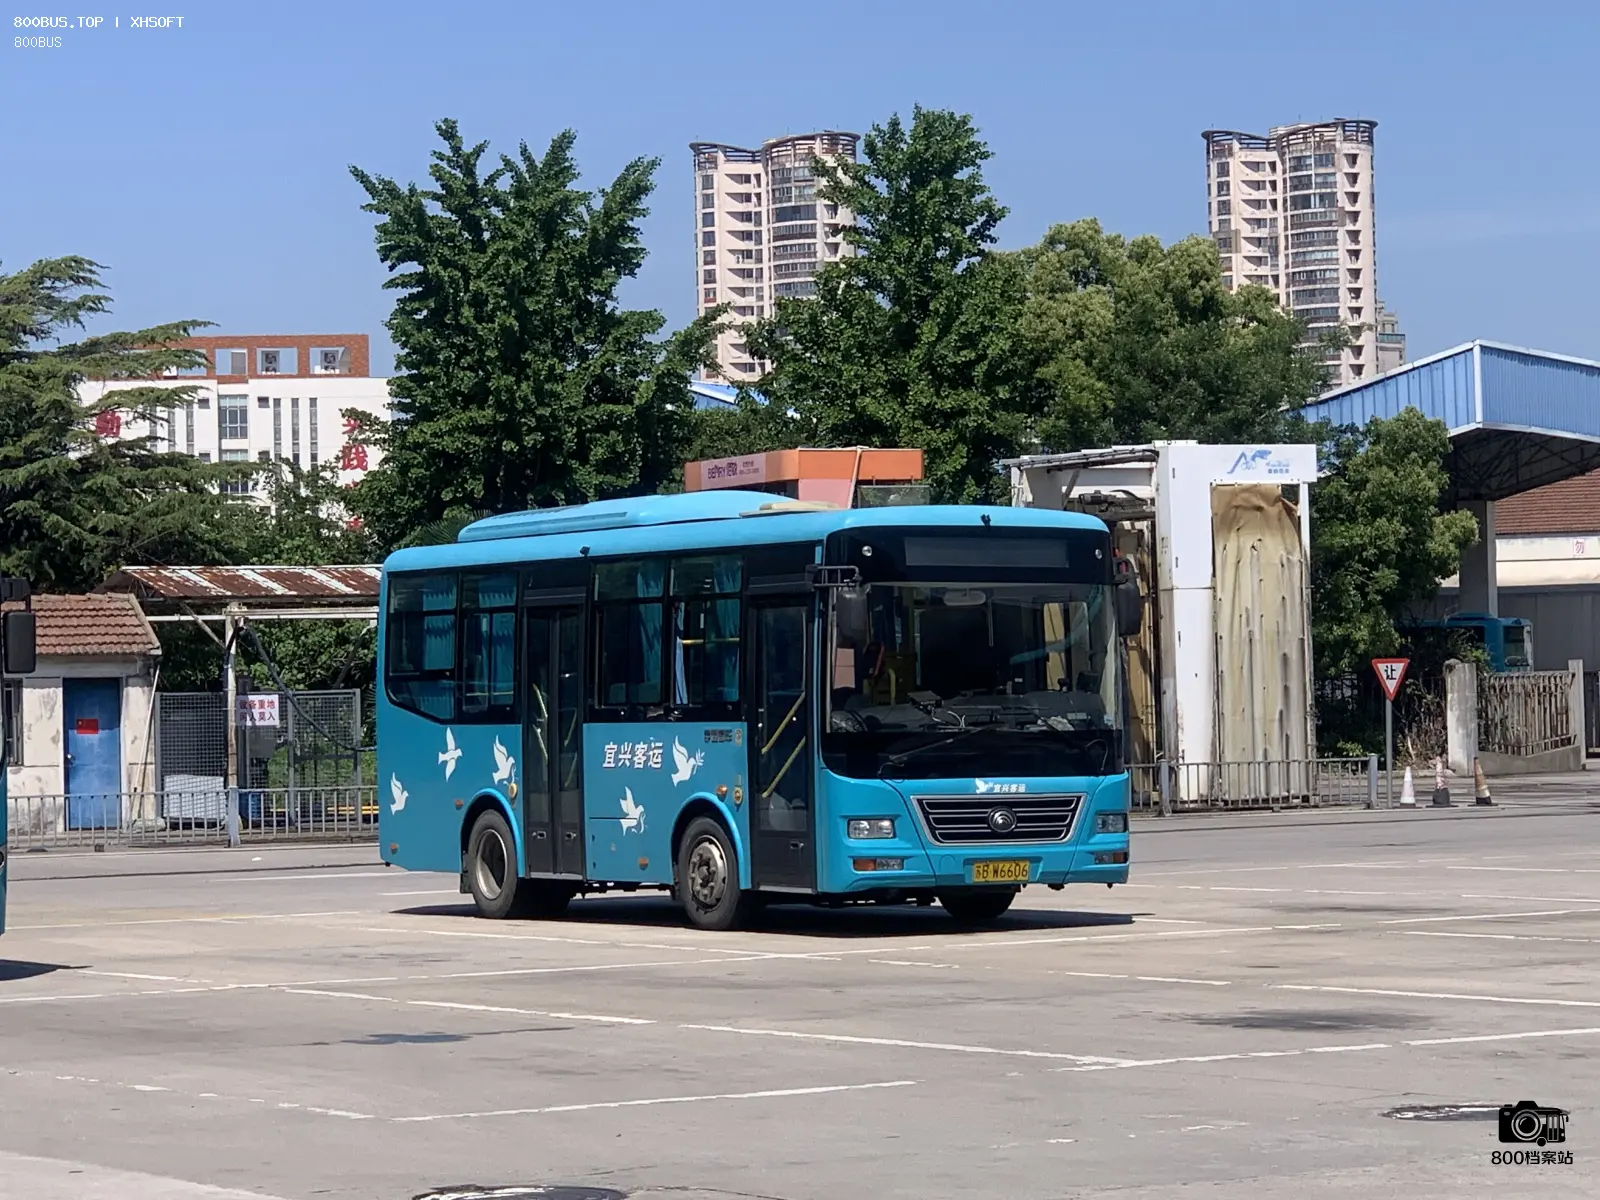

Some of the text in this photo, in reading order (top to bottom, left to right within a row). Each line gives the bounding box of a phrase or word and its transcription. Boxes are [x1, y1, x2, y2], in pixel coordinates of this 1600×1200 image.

[1384, 664, 1397, 680] 让
[602, 741, 664, 769] 宜兴客运
[993, 783, 1026, 793] 宜兴客运
